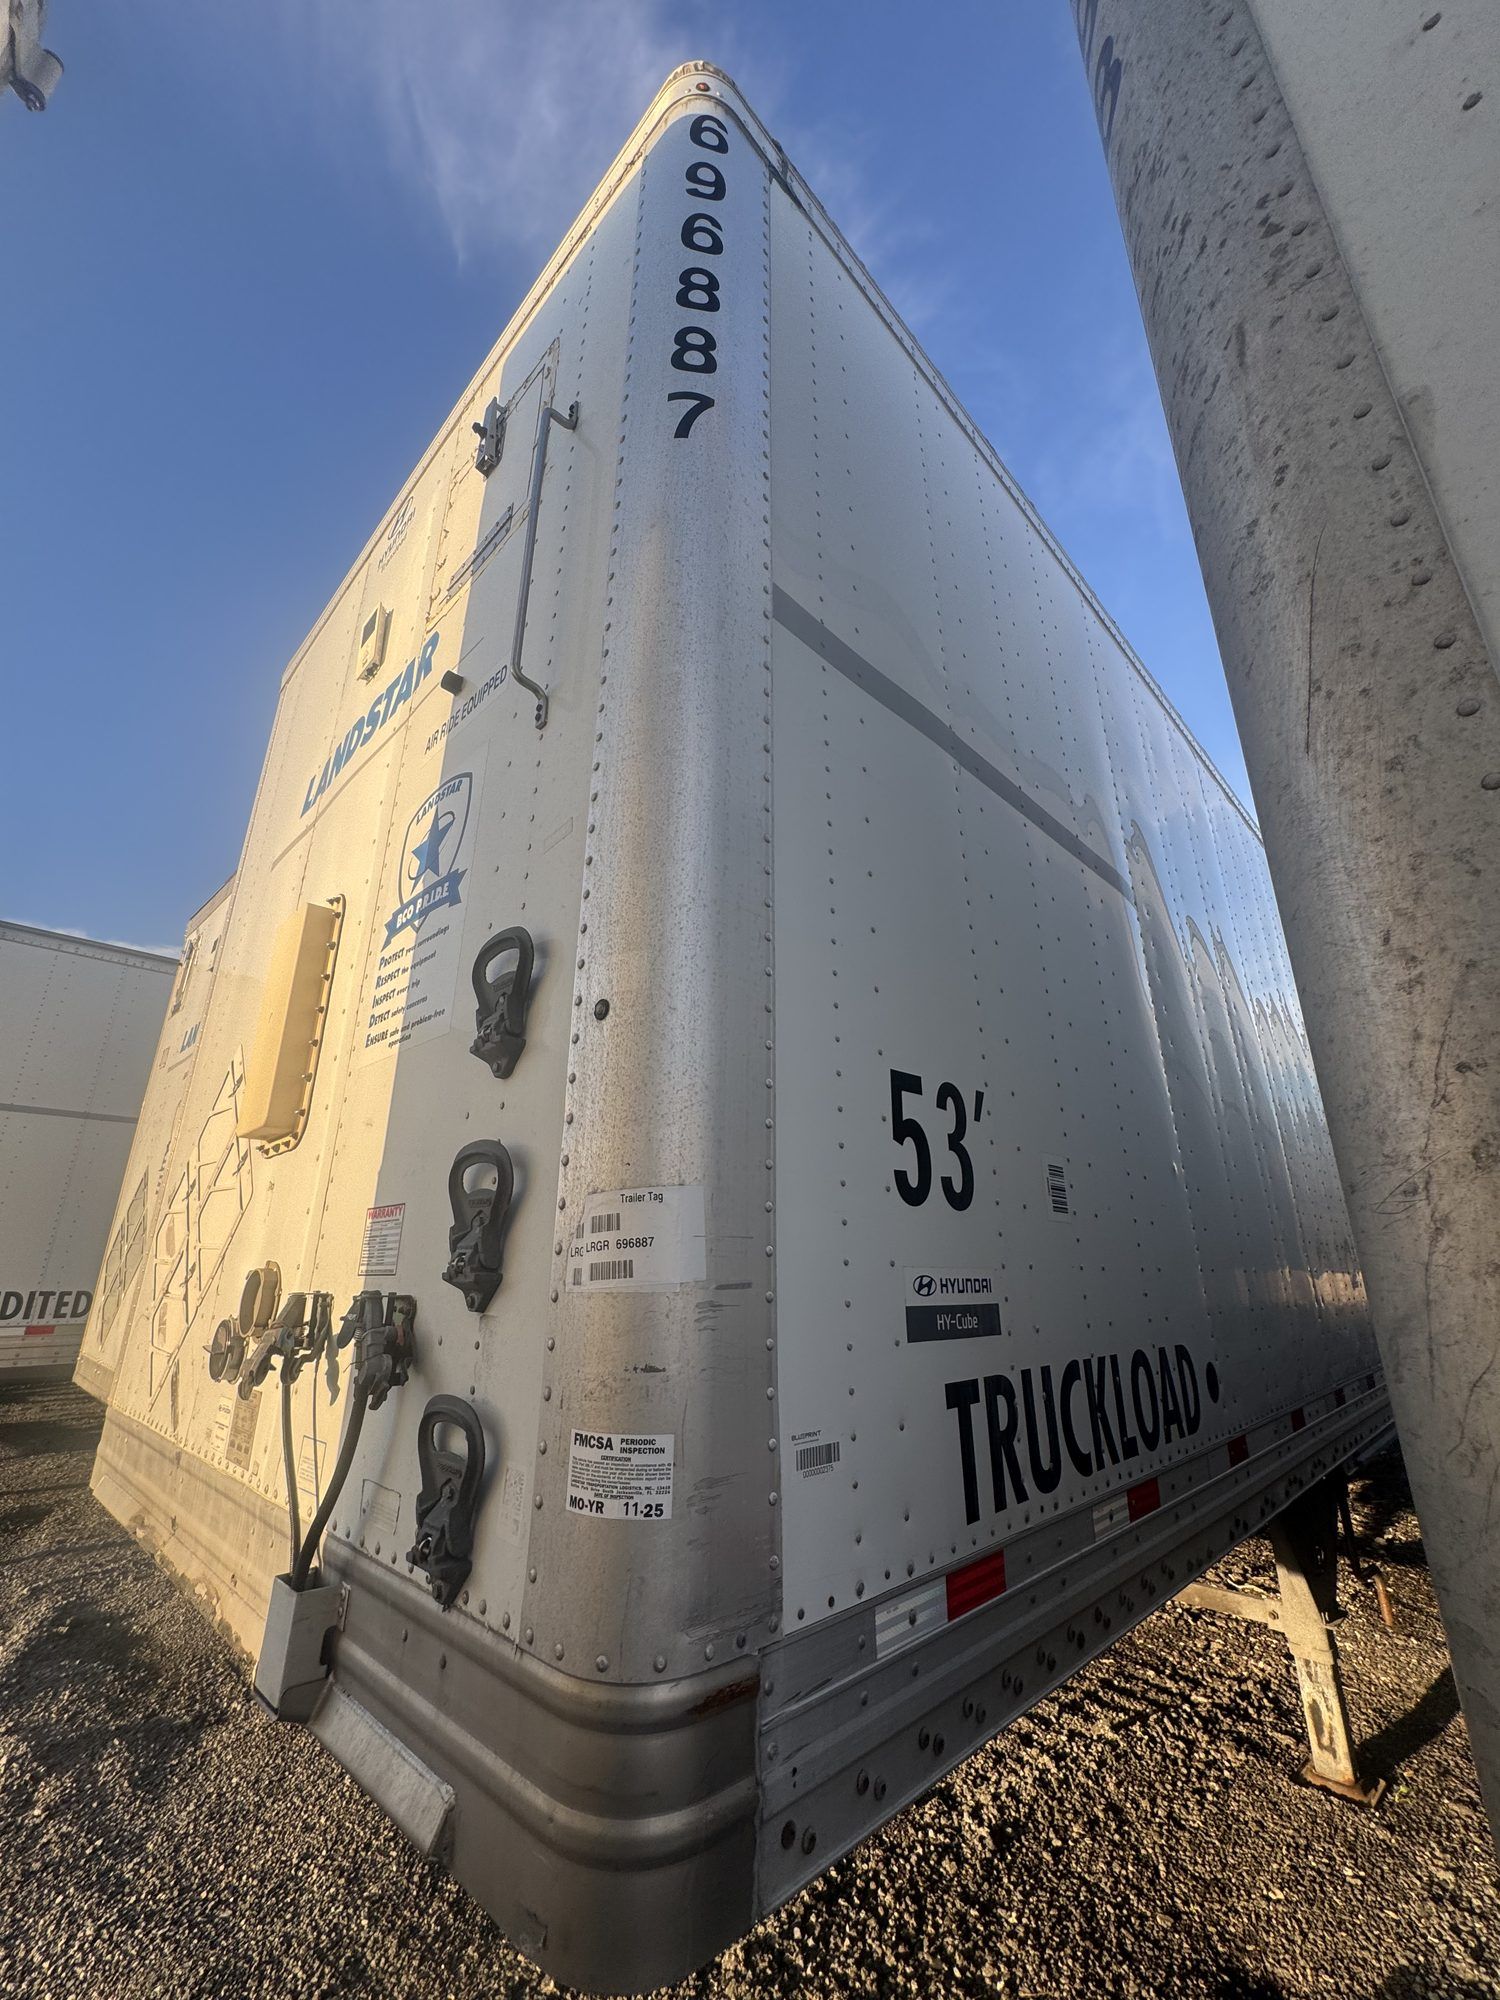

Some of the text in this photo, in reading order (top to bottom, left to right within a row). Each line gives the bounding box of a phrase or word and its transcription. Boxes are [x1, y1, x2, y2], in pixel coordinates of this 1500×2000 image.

[668, 114, 729, 439] 696887
[424, 664, 508, 755] AIR RIDE EQUIPPED
[300, 631, 440, 819] LANDSTAR
[415, 779, 463, 826] LANDSTAR
[396, 904, 414, 929] BCO
[379, 947, 405, 971] PROTECT
[417, 924, 450, 947] surroundings
[375, 968, 401, 990] RESPECT
[411, 949, 437, 970] equipment
[368, 1009, 391, 1029] DETECT
[406, 994, 428, 1011] concerns
[372, 988, 396, 1009] INSPECT
[365, 1029, 389, 1048] ENSURE
[401, 1021, 411, 1033] and
[411, 1008, 446, 1031] problem-free
[889, 1067, 985, 1212] 53'
[620, 1191, 664, 1204] Trailer Tag
[368, 1205, 404, 1219] WARRANTY
[585, 1236, 655, 1253] LRGR 696887
[940, 1277, 993, 1294] HYUNDAI
[0, 1290, 93, 1320] DITED
[936, 1313, 979, 1331] HY-Cube
[574, 1432, 614, 1451] FMCSA
[620, 1438, 657, 1446] PERIODIC
[944, 1343, 1201, 1526] TRUCKLOAD
[620, 1447, 666, 1455] INSPECTION
[569, 1495, 605, 1515] MO-YR
